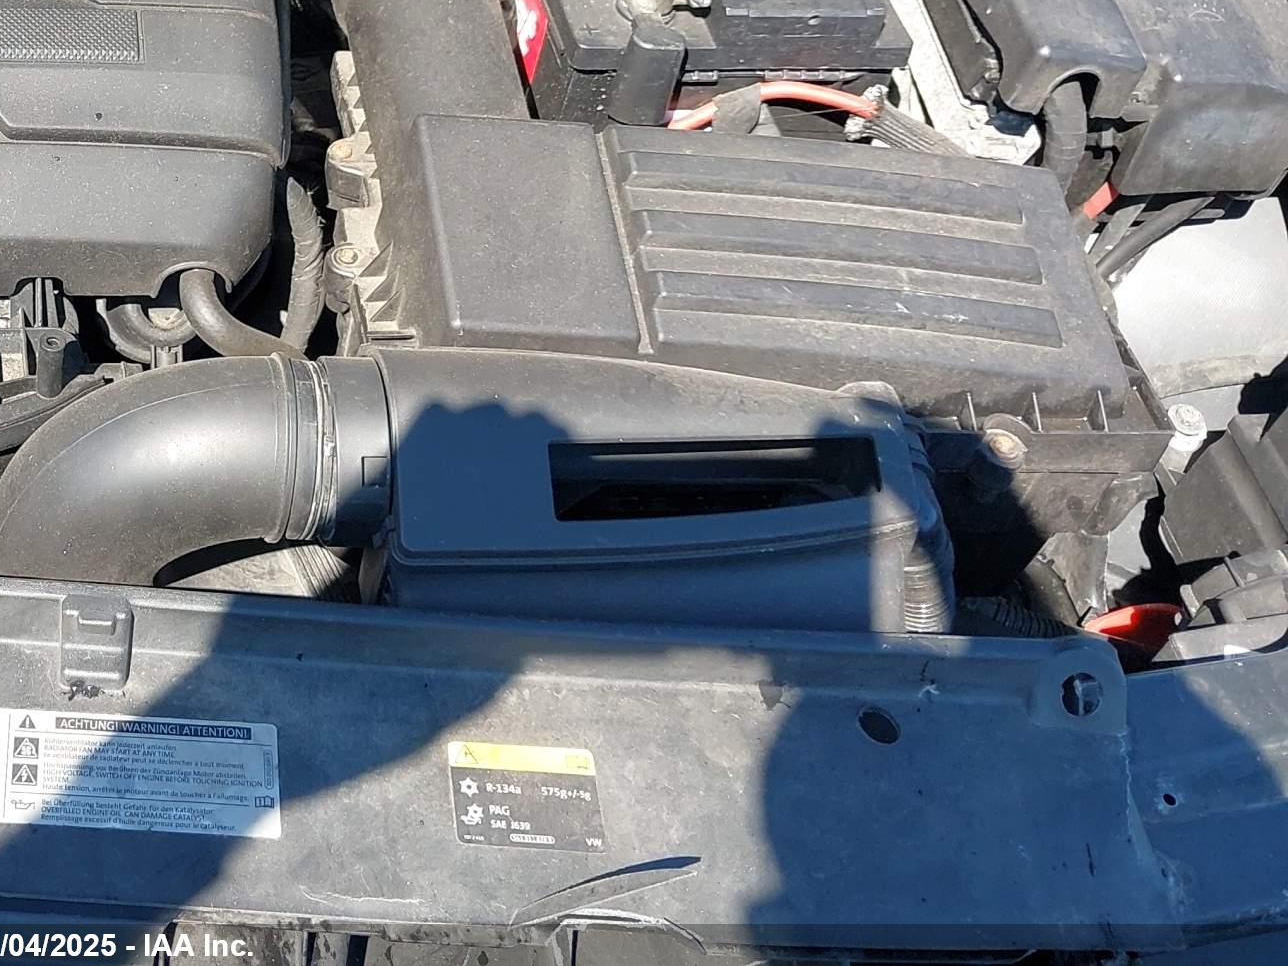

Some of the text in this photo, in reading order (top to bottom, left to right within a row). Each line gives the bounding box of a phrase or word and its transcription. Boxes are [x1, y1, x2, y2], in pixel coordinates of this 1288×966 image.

[60, 718, 246, 738] ACHTUNG! WARNING! ATTENTION!
[192, 777, 227, 785] TOUCHING
[229, 779, 262, 787] IGNITION
[485, 782, 521, 794] R-134a
[41, 806, 81, 815] OVERFILLED
[124, 810, 139, 818] CAN
[140, 811, 171, 820] DAMAGE
[488, 804, 510, 815] PAG
[490, 819, 506, 829] SAE
[585, 837, 602, 847] VW
